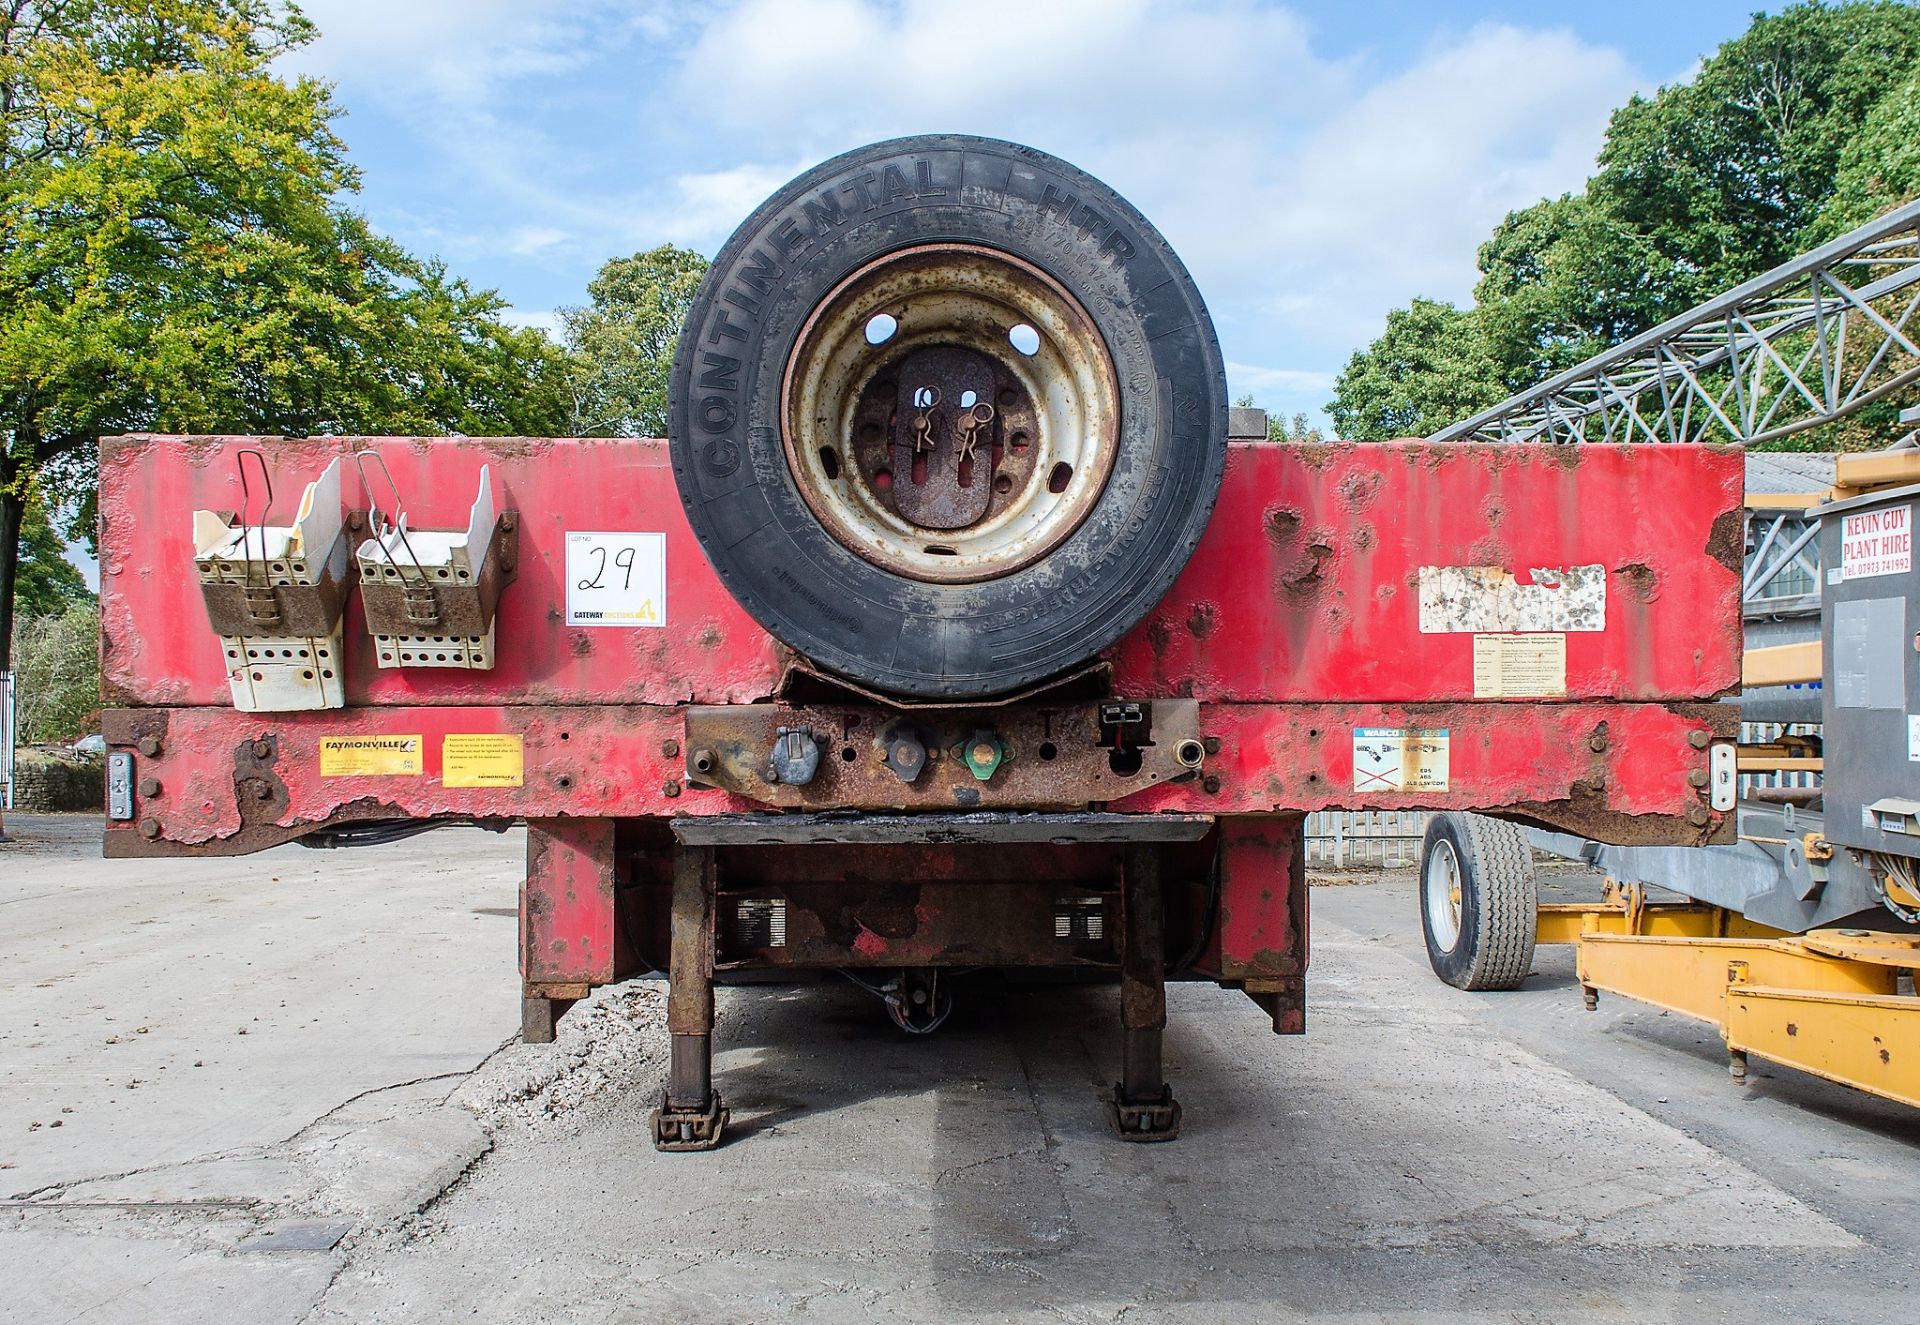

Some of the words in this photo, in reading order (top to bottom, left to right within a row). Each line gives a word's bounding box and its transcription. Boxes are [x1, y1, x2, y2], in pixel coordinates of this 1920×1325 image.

[697, 159, 946, 478] CONTINENTAL
[1036, 183, 1137, 274] HTR
[1847, 514, 1879, 536] KEVIN
[1883, 509, 1906, 530] GUY
[1843, 539, 1878, 560] PLANT
[1882, 534, 1909, 556] HIRE
[578, 547, 635, 590] 29
[1858, 562, 1879, 575] 07973
[1882, 558, 1909, 572] 741992
[574, 611, 603, 619] GATEWAY
[1364, 728, 1400, 737] WABCO
[1425, 728, 1440, 737] EBS
[326, 741, 399, 749] FAYMONVILLE
